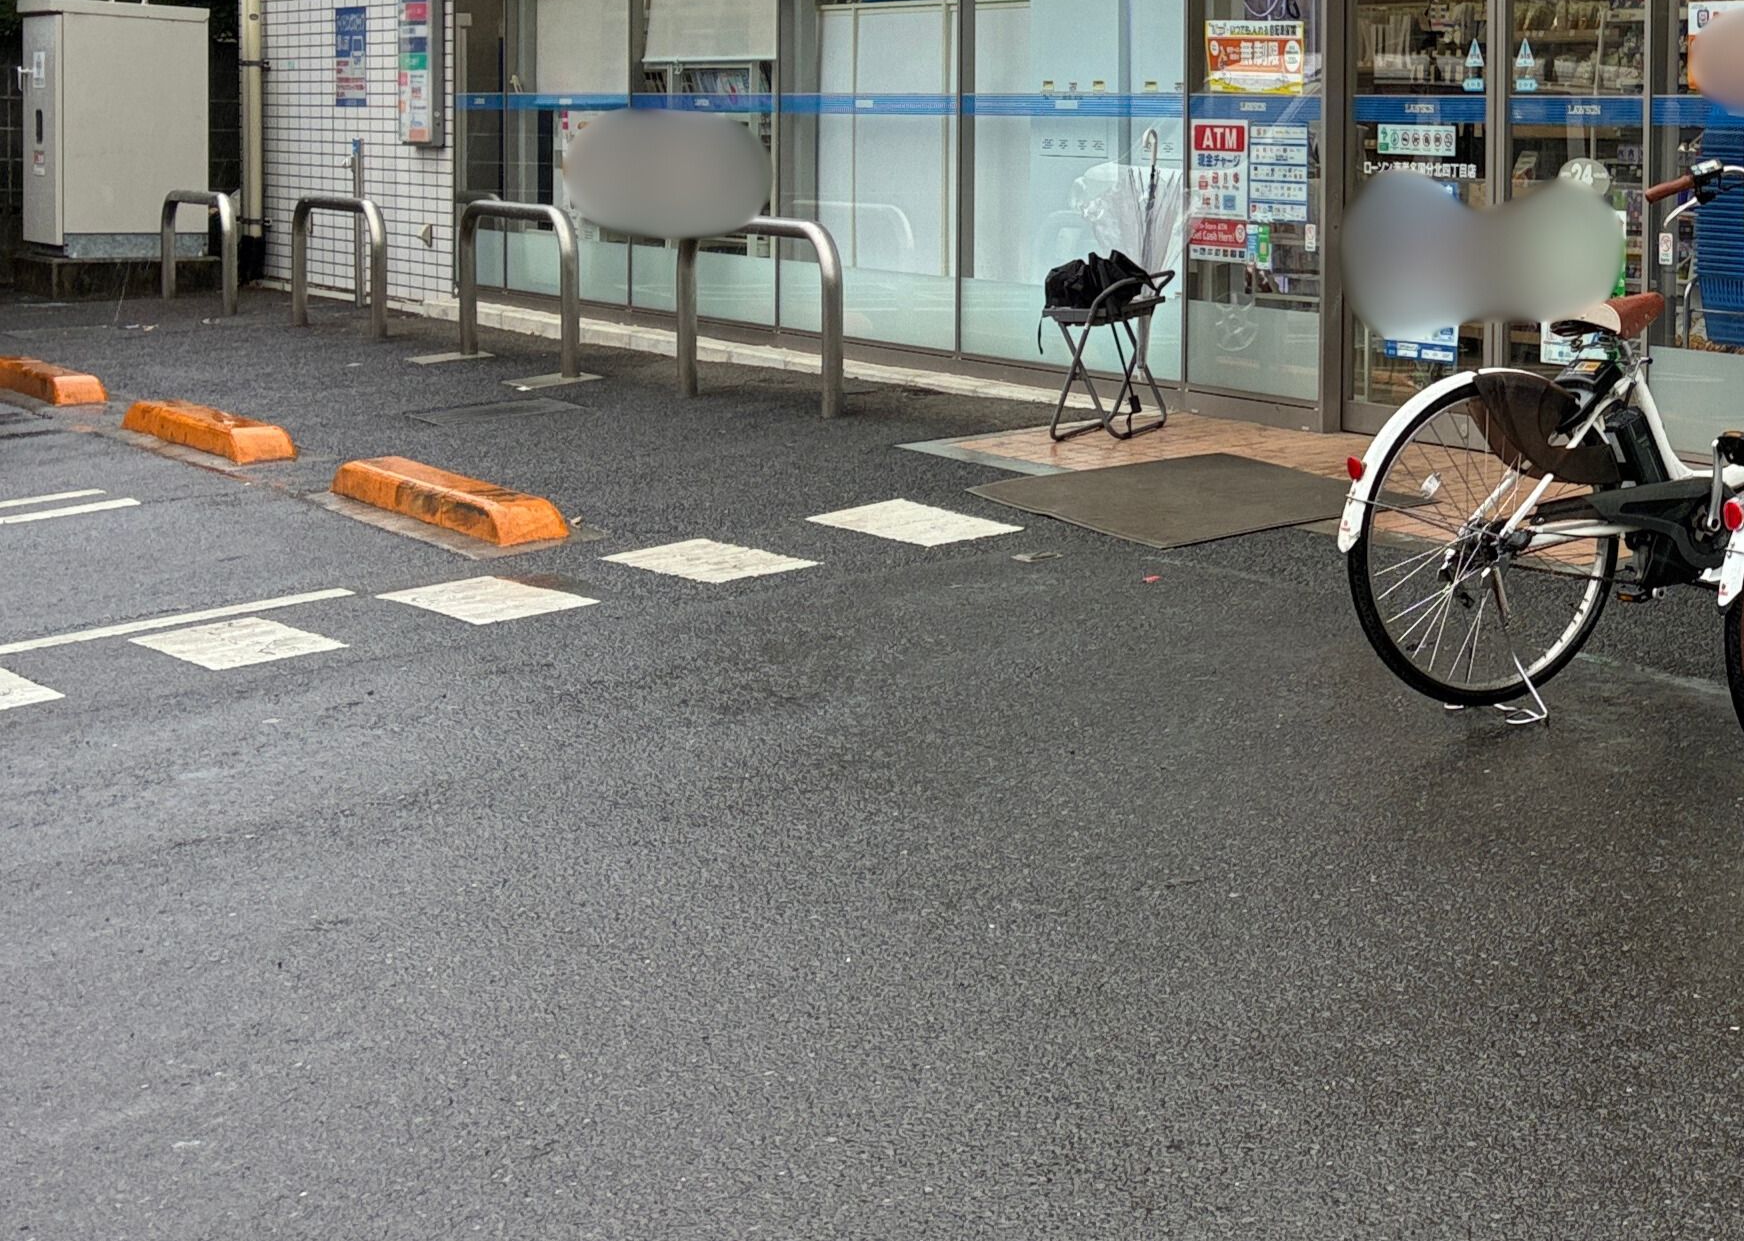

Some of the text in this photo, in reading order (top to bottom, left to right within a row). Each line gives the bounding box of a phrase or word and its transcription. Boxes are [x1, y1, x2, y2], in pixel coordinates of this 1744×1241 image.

[1240, 40, 1279, 66] 無制限
[1202, 127, 1237, 149] ATM
[1196, 153, 1241, 168] 現金チャージ
[1571, 162, 1594, 186] 24
